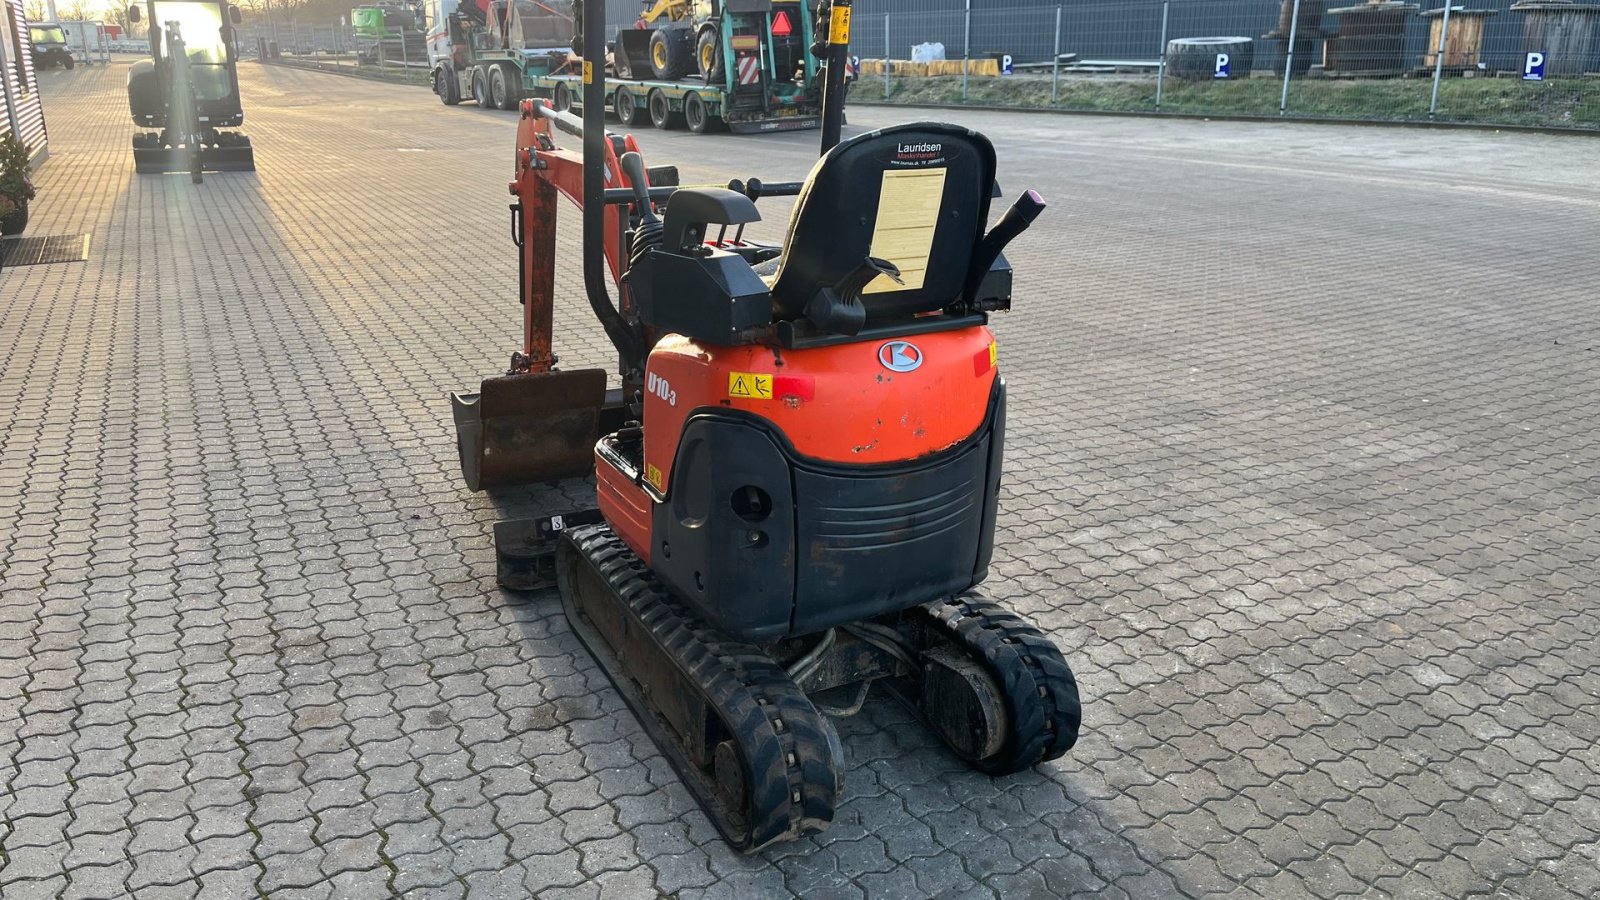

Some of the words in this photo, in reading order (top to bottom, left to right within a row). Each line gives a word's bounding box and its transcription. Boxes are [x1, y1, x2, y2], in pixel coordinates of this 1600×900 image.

[1002, 55, 1012, 70] P
[1215, 53, 1229, 72] P
[1525, 52, 1543, 73] P
[897, 142, 941, 153] Lauridsen
[648, 371, 676, 406] U10-3
